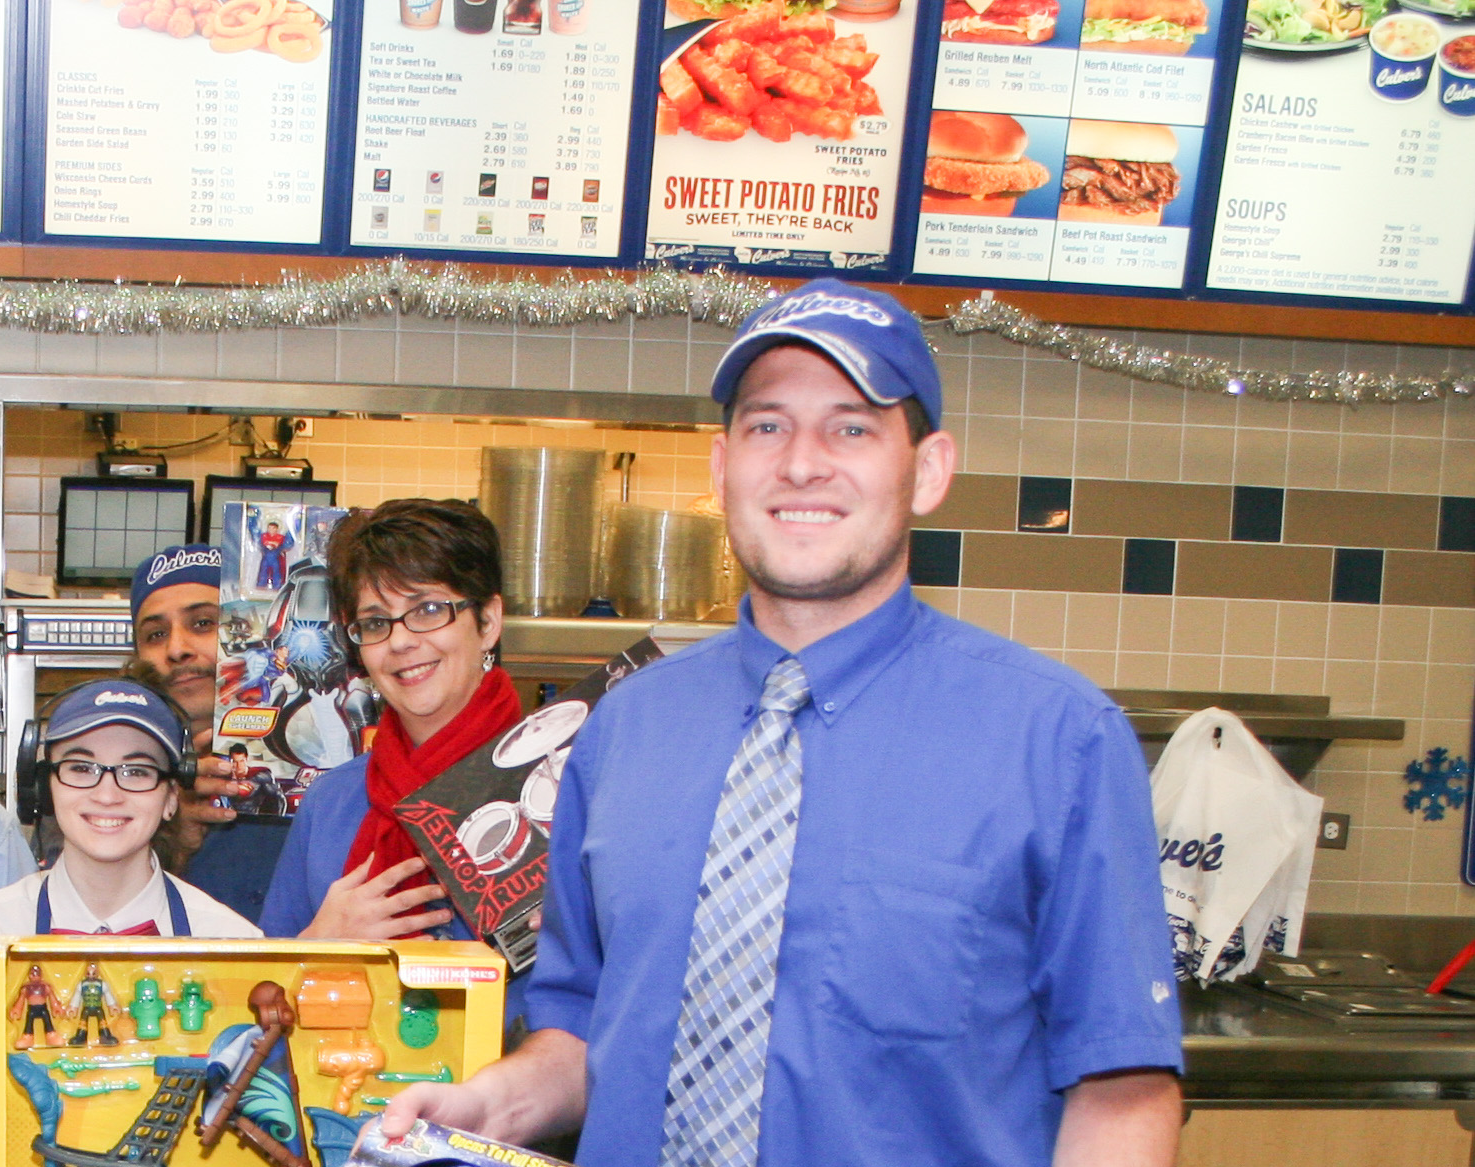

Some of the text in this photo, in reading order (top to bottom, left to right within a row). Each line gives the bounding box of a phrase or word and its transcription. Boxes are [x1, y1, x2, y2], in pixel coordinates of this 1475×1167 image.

[389, 43, 414, 53] Drinks
[492, 50, 514, 59] 1.69
[945, 49, 1032, 65] Grilled Reuben Melt
[491, 63, 513, 72] 1.69
[1084, 59, 1185, 76] North Atlantic Cod Filet
[1376, 67, 1422, 88] Culver's
[1242, 92, 1318, 118] SALADS
[366, 114, 477, 128] HANDCRAFTED BEVERAGES
[859, 119, 888, 131] $2.79
[484, 132, 580, 145] 2.39 2.99
[364, 139, 578, 158] Shake 2.69 3.79
[815, 144, 887, 157] SWEET POTATO
[482, 159, 577, 171] 2.79 3.89
[836, 156, 863, 166] FRIES
[191, 191, 214, 200] 2.99
[664, 175, 880, 220] SWEET POTATO FRIES
[1226, 198, 1287, 222] SOUPS
[686, 211, 853, 234] SWEET, THEY'RE BACK
[925, 221, 1038, 237] Pork Tenderloin Sandwich
[732, 230, 805, 242] LIMITED TIME ONLY
[1062, 228, 1167, 245] Beef Pot Roast Sandwich
[981, 250, 1002, 260] 7.99
[1116, 257, 1137, 267] 7.79
[228, 714, 270, 724] LAUNCH
[393, 800, 495, 893] DESKTOP
[447, 1133, 488, 1155] Opens
[487, 1144, 505, 1161] To
